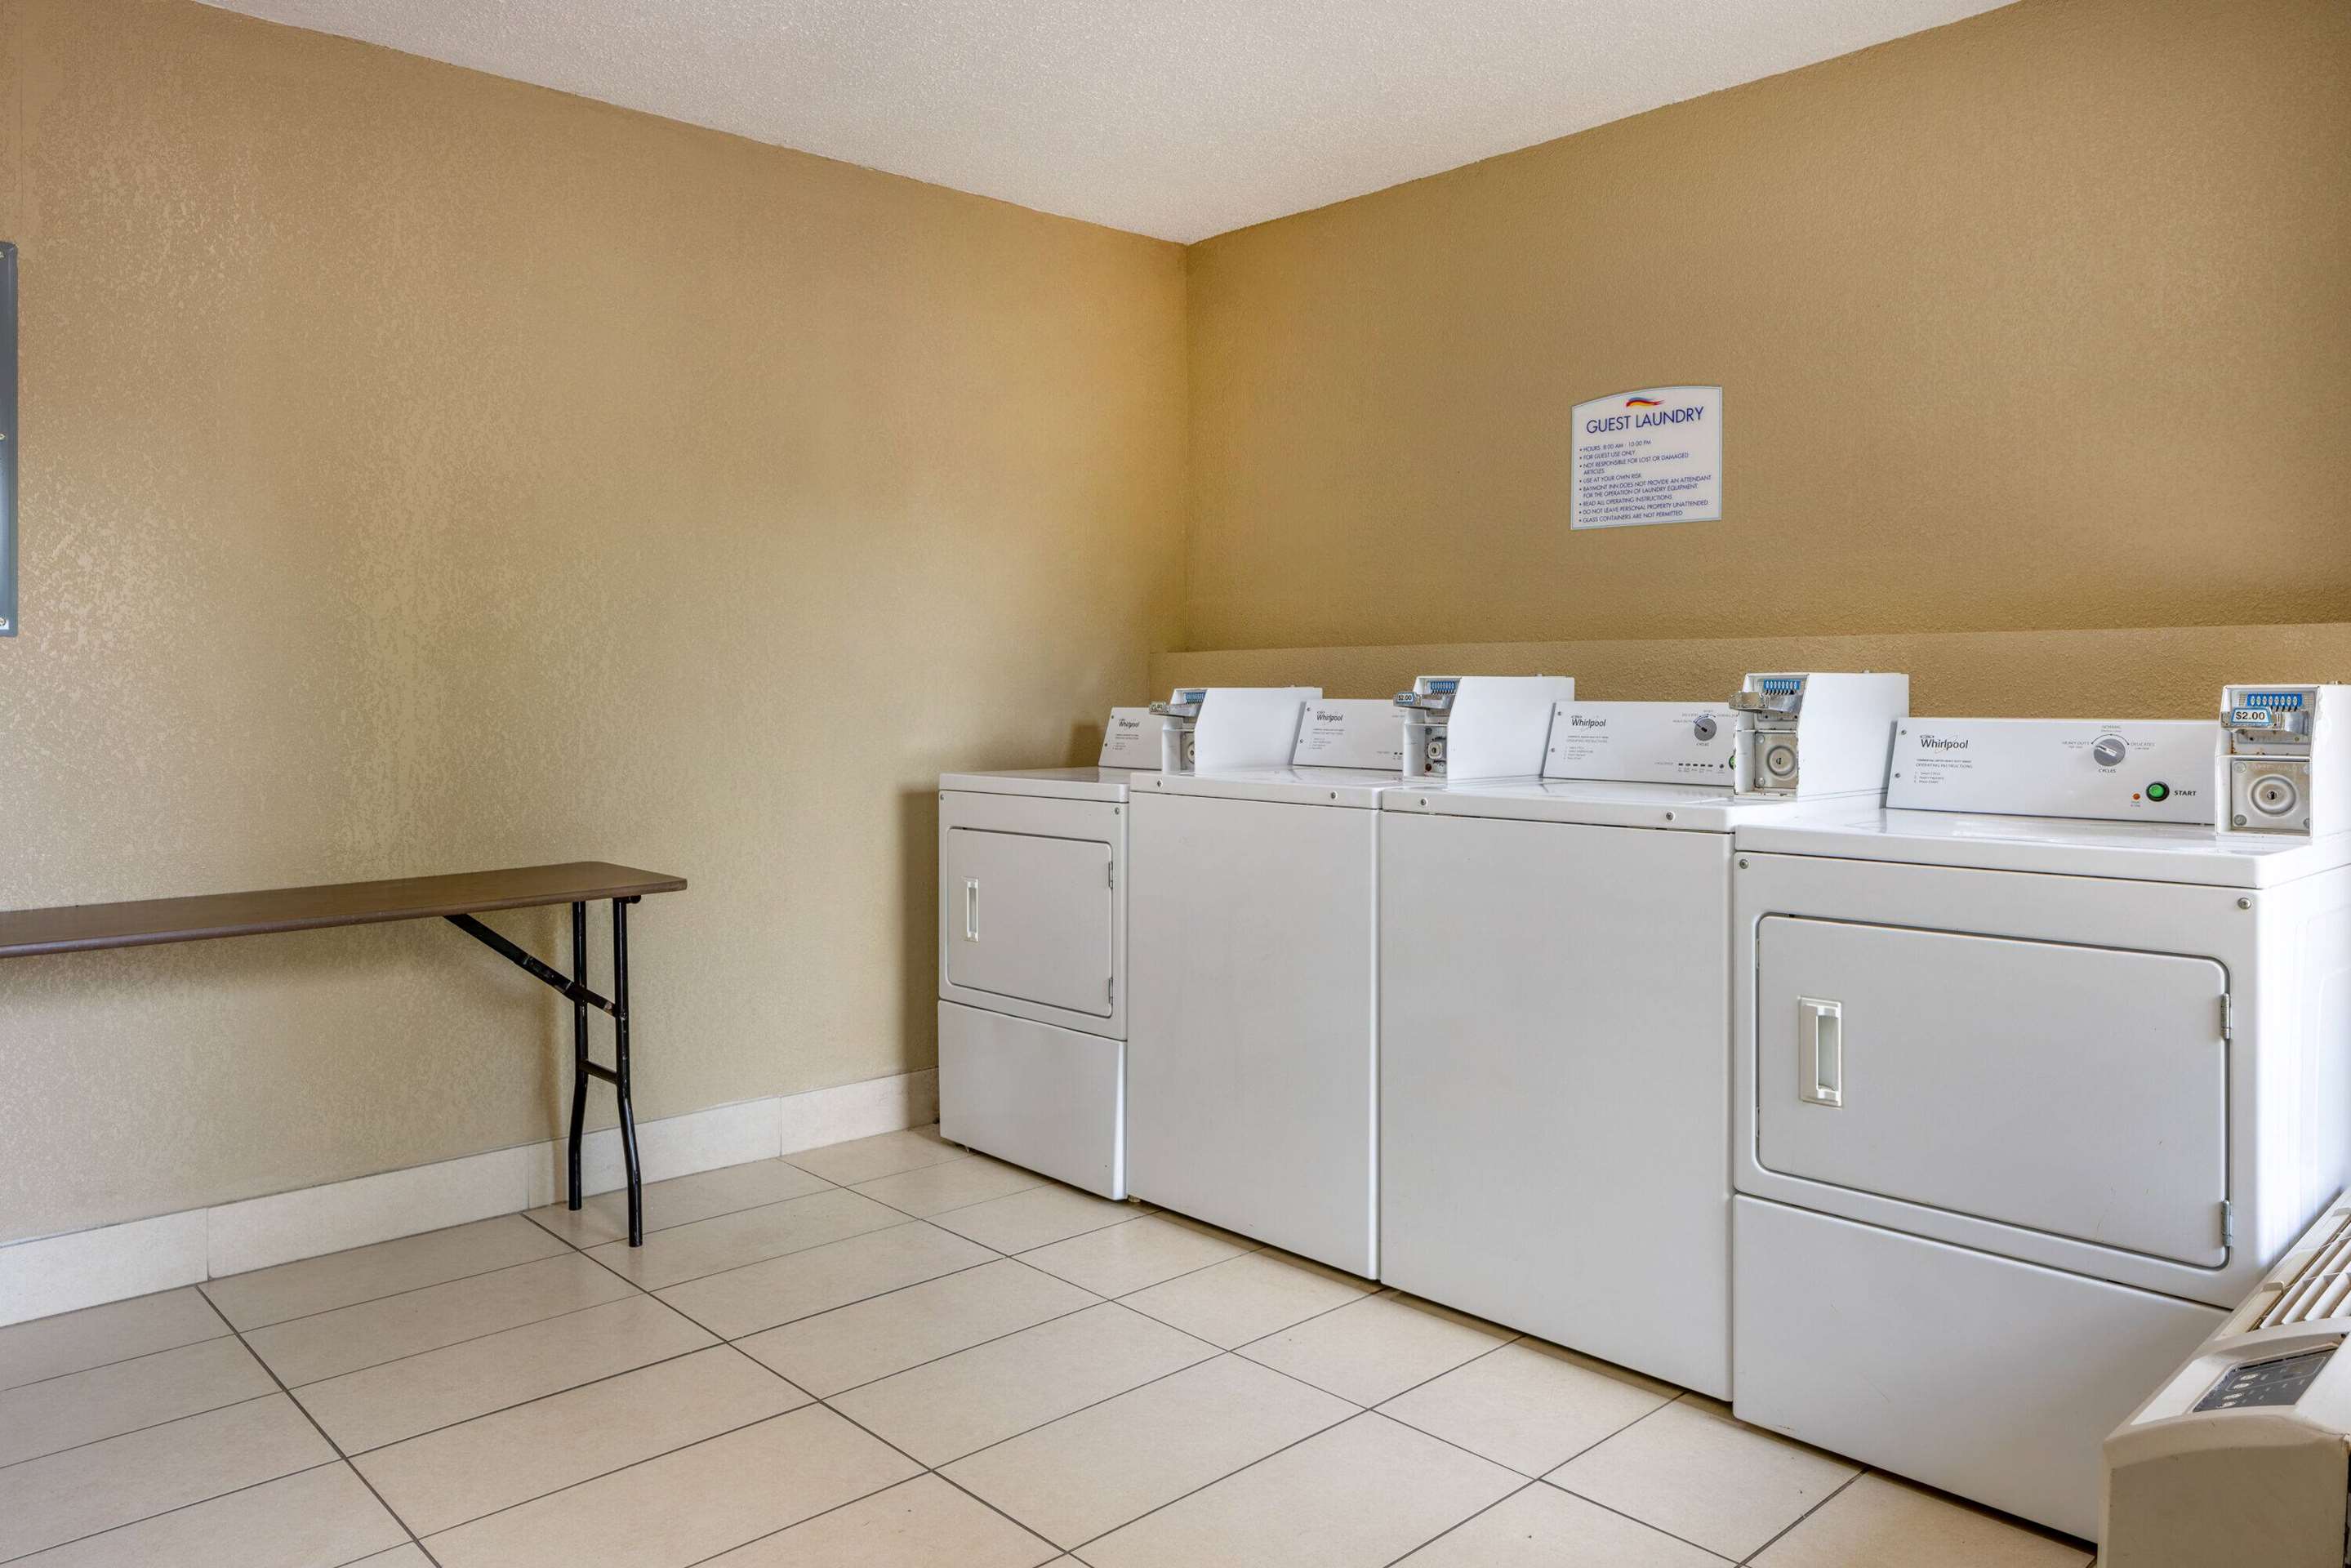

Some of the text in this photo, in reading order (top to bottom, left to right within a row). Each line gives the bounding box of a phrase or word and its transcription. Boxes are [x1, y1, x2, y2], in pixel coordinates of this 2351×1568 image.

[1587, 407, 1704, 434] GUEST LAUNDRY
[1595, 459, 1626, 467] RESPONSIBLE
[1661, 452, 1689, 461] DAMAGED
[1680, 474, 1711, 483] ATTENDANT
[1642, 486, 1666, 494] LAUNDRY
[1636, 494, 1672, 502] INSTRUCTIONS
[1317, 714, 1342, 722] Whirlpool
[2236, 711, 2265, 720] $2.00
[1572, 719, 1606, 728] Whirlpool
[1921, 739, 1969, 751] Whirlpool
